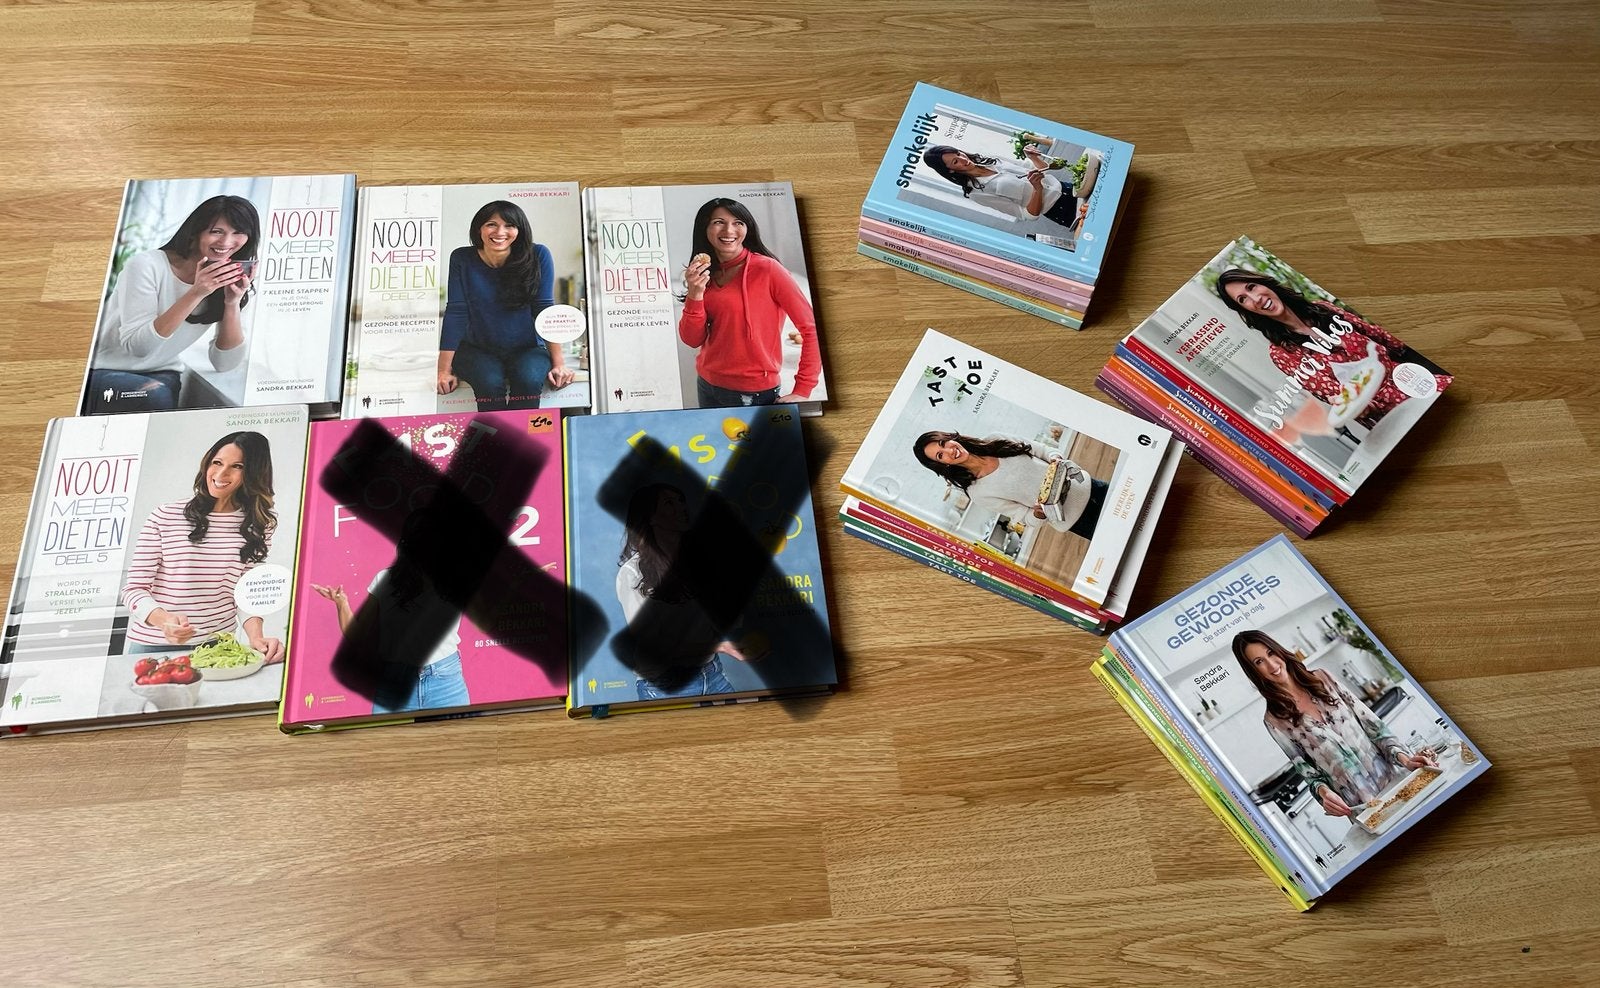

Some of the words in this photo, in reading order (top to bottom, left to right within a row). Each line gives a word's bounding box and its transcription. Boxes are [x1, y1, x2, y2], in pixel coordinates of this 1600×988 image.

[896, 113, 939, 188] smakelijk
[270, 210, 340, 238] NOOIT
[372, 220, 439, 249] NOOIT
[602, 222, 664, 250] NOOIT
[886, 229, 924, 245] smakelijk
[888, 217, 927, 233] smakelijk
[268, 239, 335, 254] MEER
[371, 248, 436, 264] MEER
[603, 250, 665, 265] MEER
[884, 241, 922, 258] smakelijk
[264, 255, 334, 281] DIËTEN
[883, 255, 920, 272] smakelijk
[369, 264, 436, 290] DIËTEN
[604, 266, 668, 292] DIËTEN
[382, 293, 414, 301] DEEL
[416, 292, 426, 300] 2
[614, 294, 646, 303] DEEL
[647, 293, 657, 303] 3
[1163, 328, 1183, 345] SANDRA
[1180, 312, 1200, 330] BEKKARI
[1176, 317, 1219, 355] VERRASSEND
[1185, 323, 1227, 362] APERITIEVEN
[926, 356, 957, 407] TAST
[957, 360, 983, 396] TOE
[1253, 356, 1326, 430] Summer
[1302, 314, 1354, 356] Vibes
[973, 391, 988, 414] SANDRA
[984, 368, 1000, 393] BEKKARI
[225, 418, 262, 427] SANDRA
[263, 416, 300, 425] BEKKARI
[1231, 420, 1269, 450] VERRASSEND
[1269, 447, 1308, 478] APERITIEVEN
[55, 458, 138, 497] NOOIT
[51, 496, 129, 517] MEER
[44, 517, 126, 551] DIËTEN
[506, 504, 541, 547] 2
[926, 526, 951, 540] TAST
[55, 553, 93, 566] DEEL
[97, 552, 108, 562] 5
[923, 551, 948, 565] TAST
[952, 563, 972, 575] TOE
[932, 545, 959, 559] TAST
[961, 558, 982, 569] TOE
[945, 541, 971, 556] TAST
[974, 555, 994, 567] TOE
[245, 578, 286, 586] EENVOUDIGE
[928, 561, 953, 575] TAST
[956, 573, 977, 585] TOE
[44, 587, 101, 598] STRALENDSTE
[1174, 573, 1256, 627] GEZONDE
[54, 606, 83, 615] JEZELF
[1167, 575, 1281, 650] GEWOONTES
[1202, 633, 1214, 643] De
[1214, 623, 1231, 637] start
[1230, 615, 1245, 626] van
[1242, 610, 1251, 620] je
[1250, 602, 1265, 614] dag
[474, 640, 484, 648] 80
[1193, 664, 1223, 685] Sandra
[1199, 669, 1231, 692] Bekkari
[1134, 688, 1167, 726] GEZONDE
[1167, 727, 1212, 783] GEWOONTES
[1141, 677, 1173, 718] GEZONDE
[1173, 718, 1219, 775] GEWOONTES
